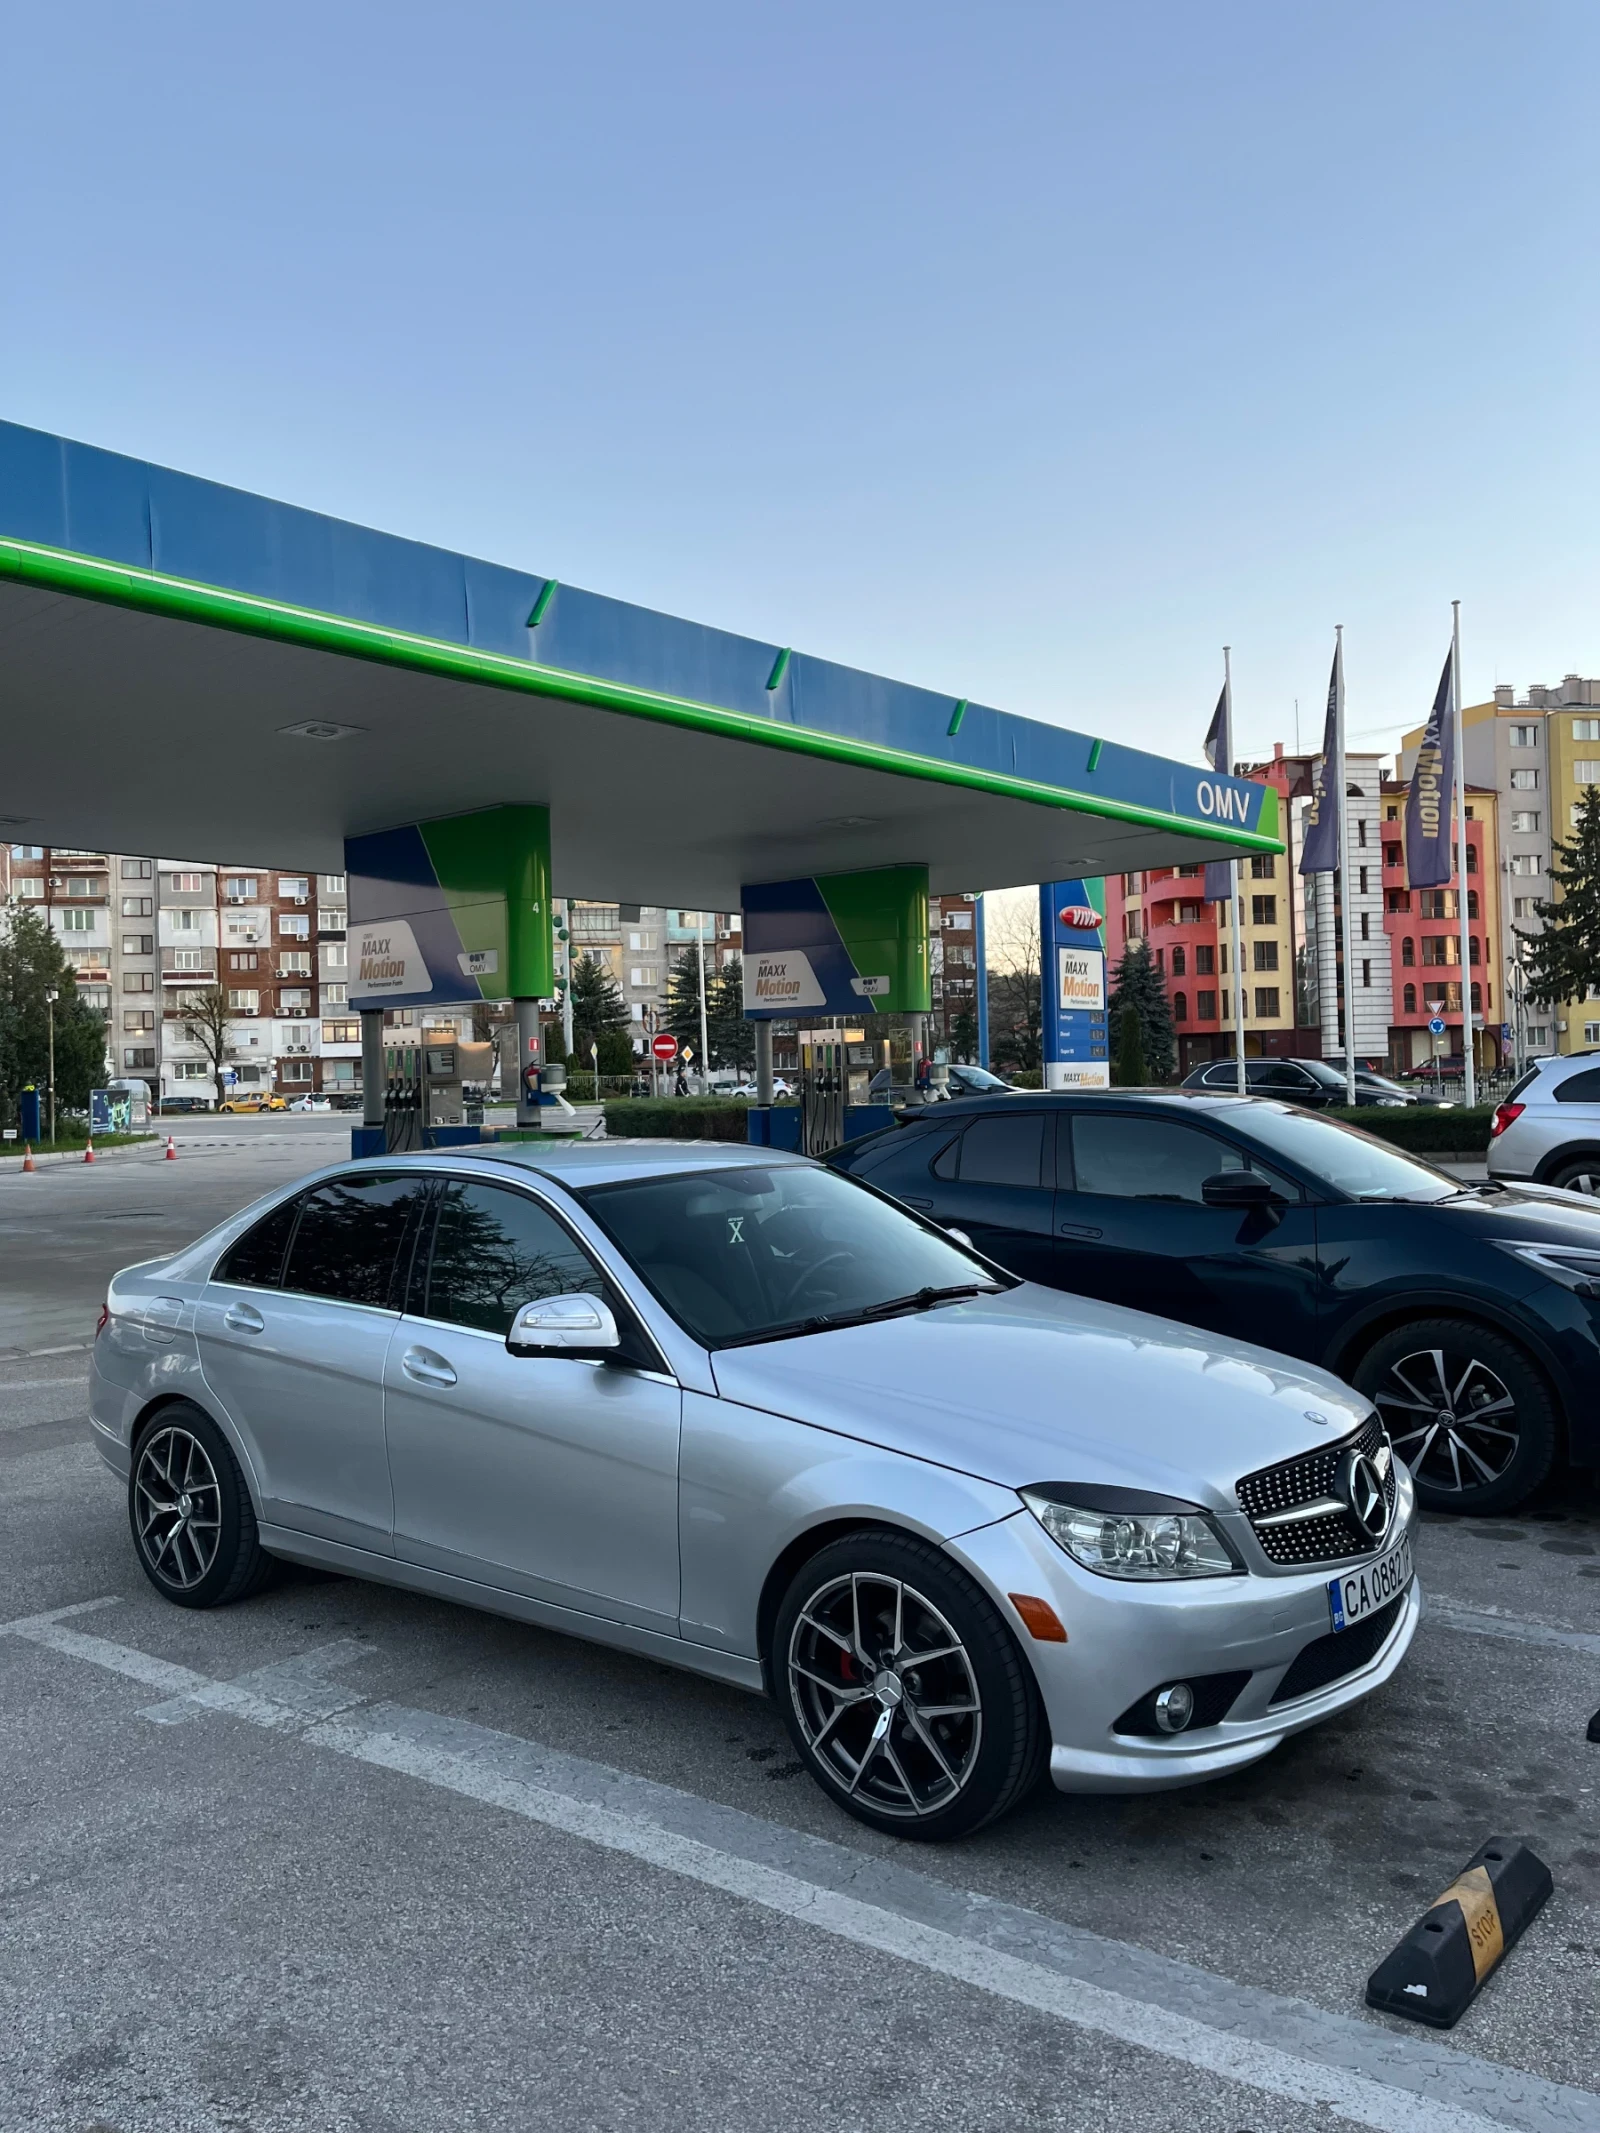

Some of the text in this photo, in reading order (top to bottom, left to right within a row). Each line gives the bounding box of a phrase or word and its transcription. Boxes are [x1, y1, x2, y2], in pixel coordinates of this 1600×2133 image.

[1196, 780, 1250, 823] OMV
[1418, 748, 1444, 838] Motion
[532, 901, 540, 914] 4
[1072, 908, 1096, 927] VIVA
[361, 938, 391, 957] MAXX
[917, 944, 923, 954] 2
[359, 956, 405, 981] Motion
[469, 964, 486, 973] OMV
[757, 964, 787, 978] MAXX
[1065, 960, 1089, 976] MAXX
[755, 977, 801, 996] Motion
[862, 986, 879, 994] OMV
[1063, 976, 1099, 998] Motion
[1063, 1071, 1105, 1087] MAXX Motion
[1344, 1574, 1371, 1618] CA
[1372, 1551, 1402, 1602] 0882
[1333, 1610, 1344, 1625] BG
[1470, 1909, 1499, 1948] STOP
